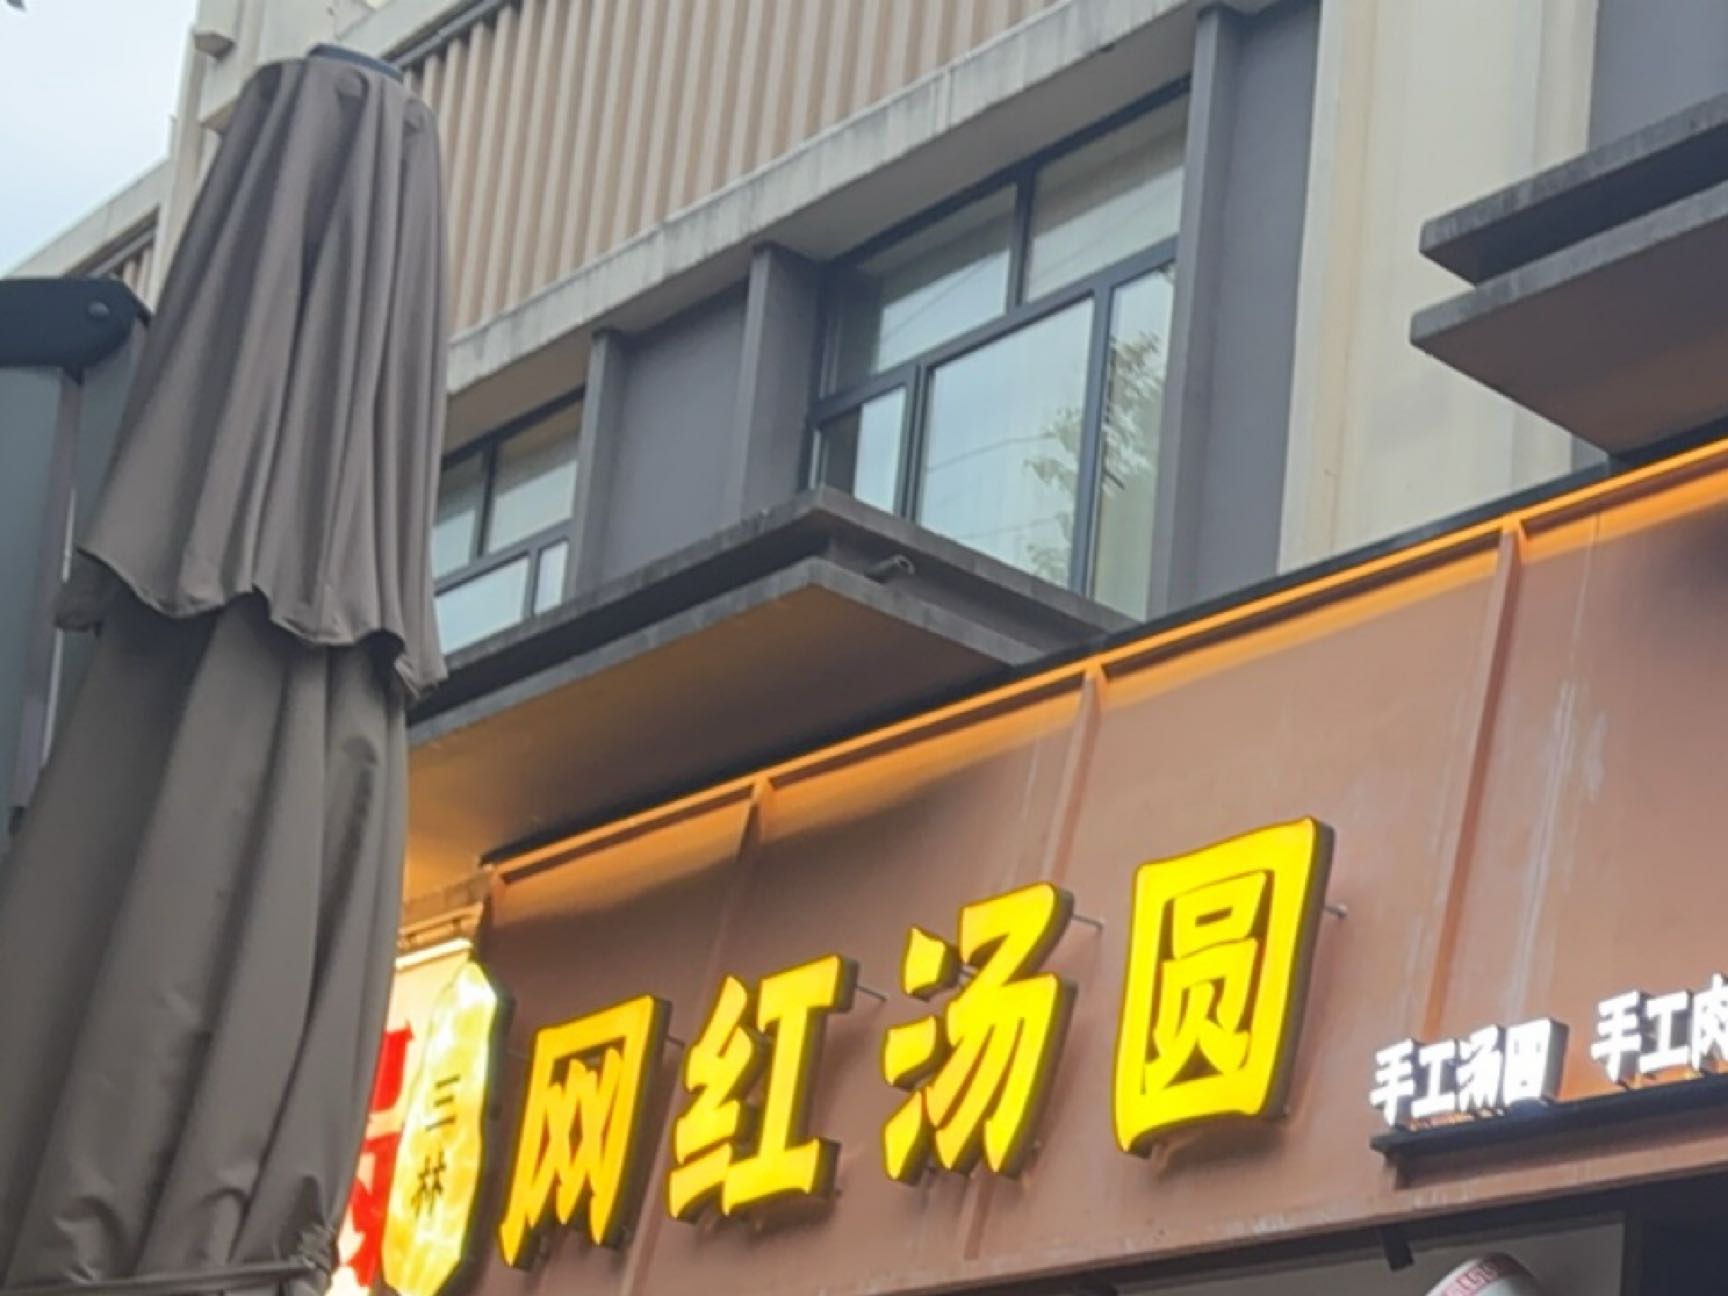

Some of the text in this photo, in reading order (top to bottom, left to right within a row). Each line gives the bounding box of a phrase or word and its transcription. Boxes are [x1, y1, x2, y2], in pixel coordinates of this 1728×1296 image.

[412, 1073, 460, 1217] 三林
[499, 817, 1324, 1268] 网红汤圆
